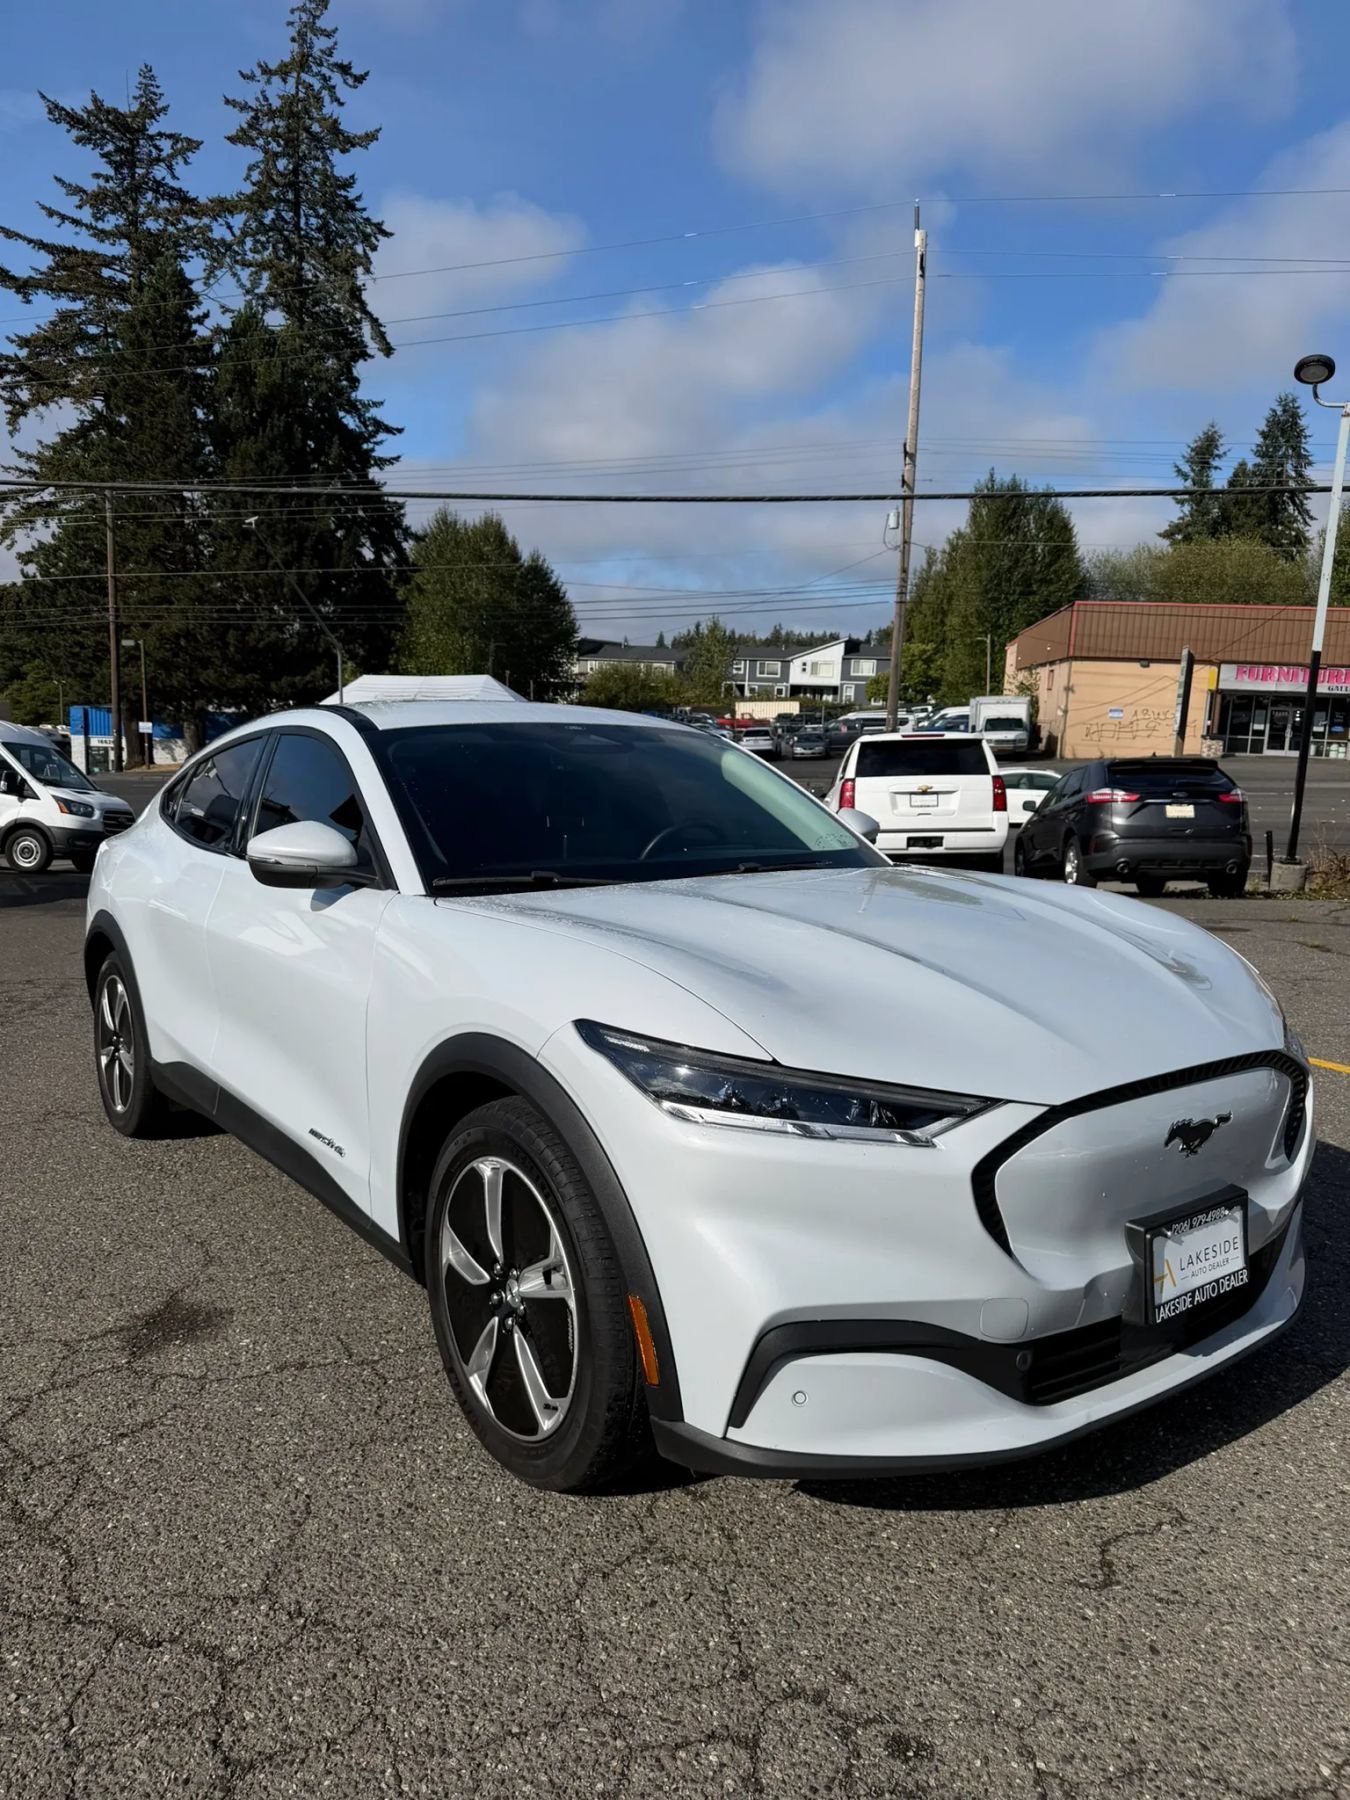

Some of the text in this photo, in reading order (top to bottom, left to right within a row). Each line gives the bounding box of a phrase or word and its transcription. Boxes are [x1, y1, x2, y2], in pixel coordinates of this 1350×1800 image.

[1180, 1236, 1239, 1271] LAKESIDE
[1191, 1257, 1230, 1278] AUTO DEALER
[1155, 1269, 1249, 1323] LAKESIDE AUTO DEALER
